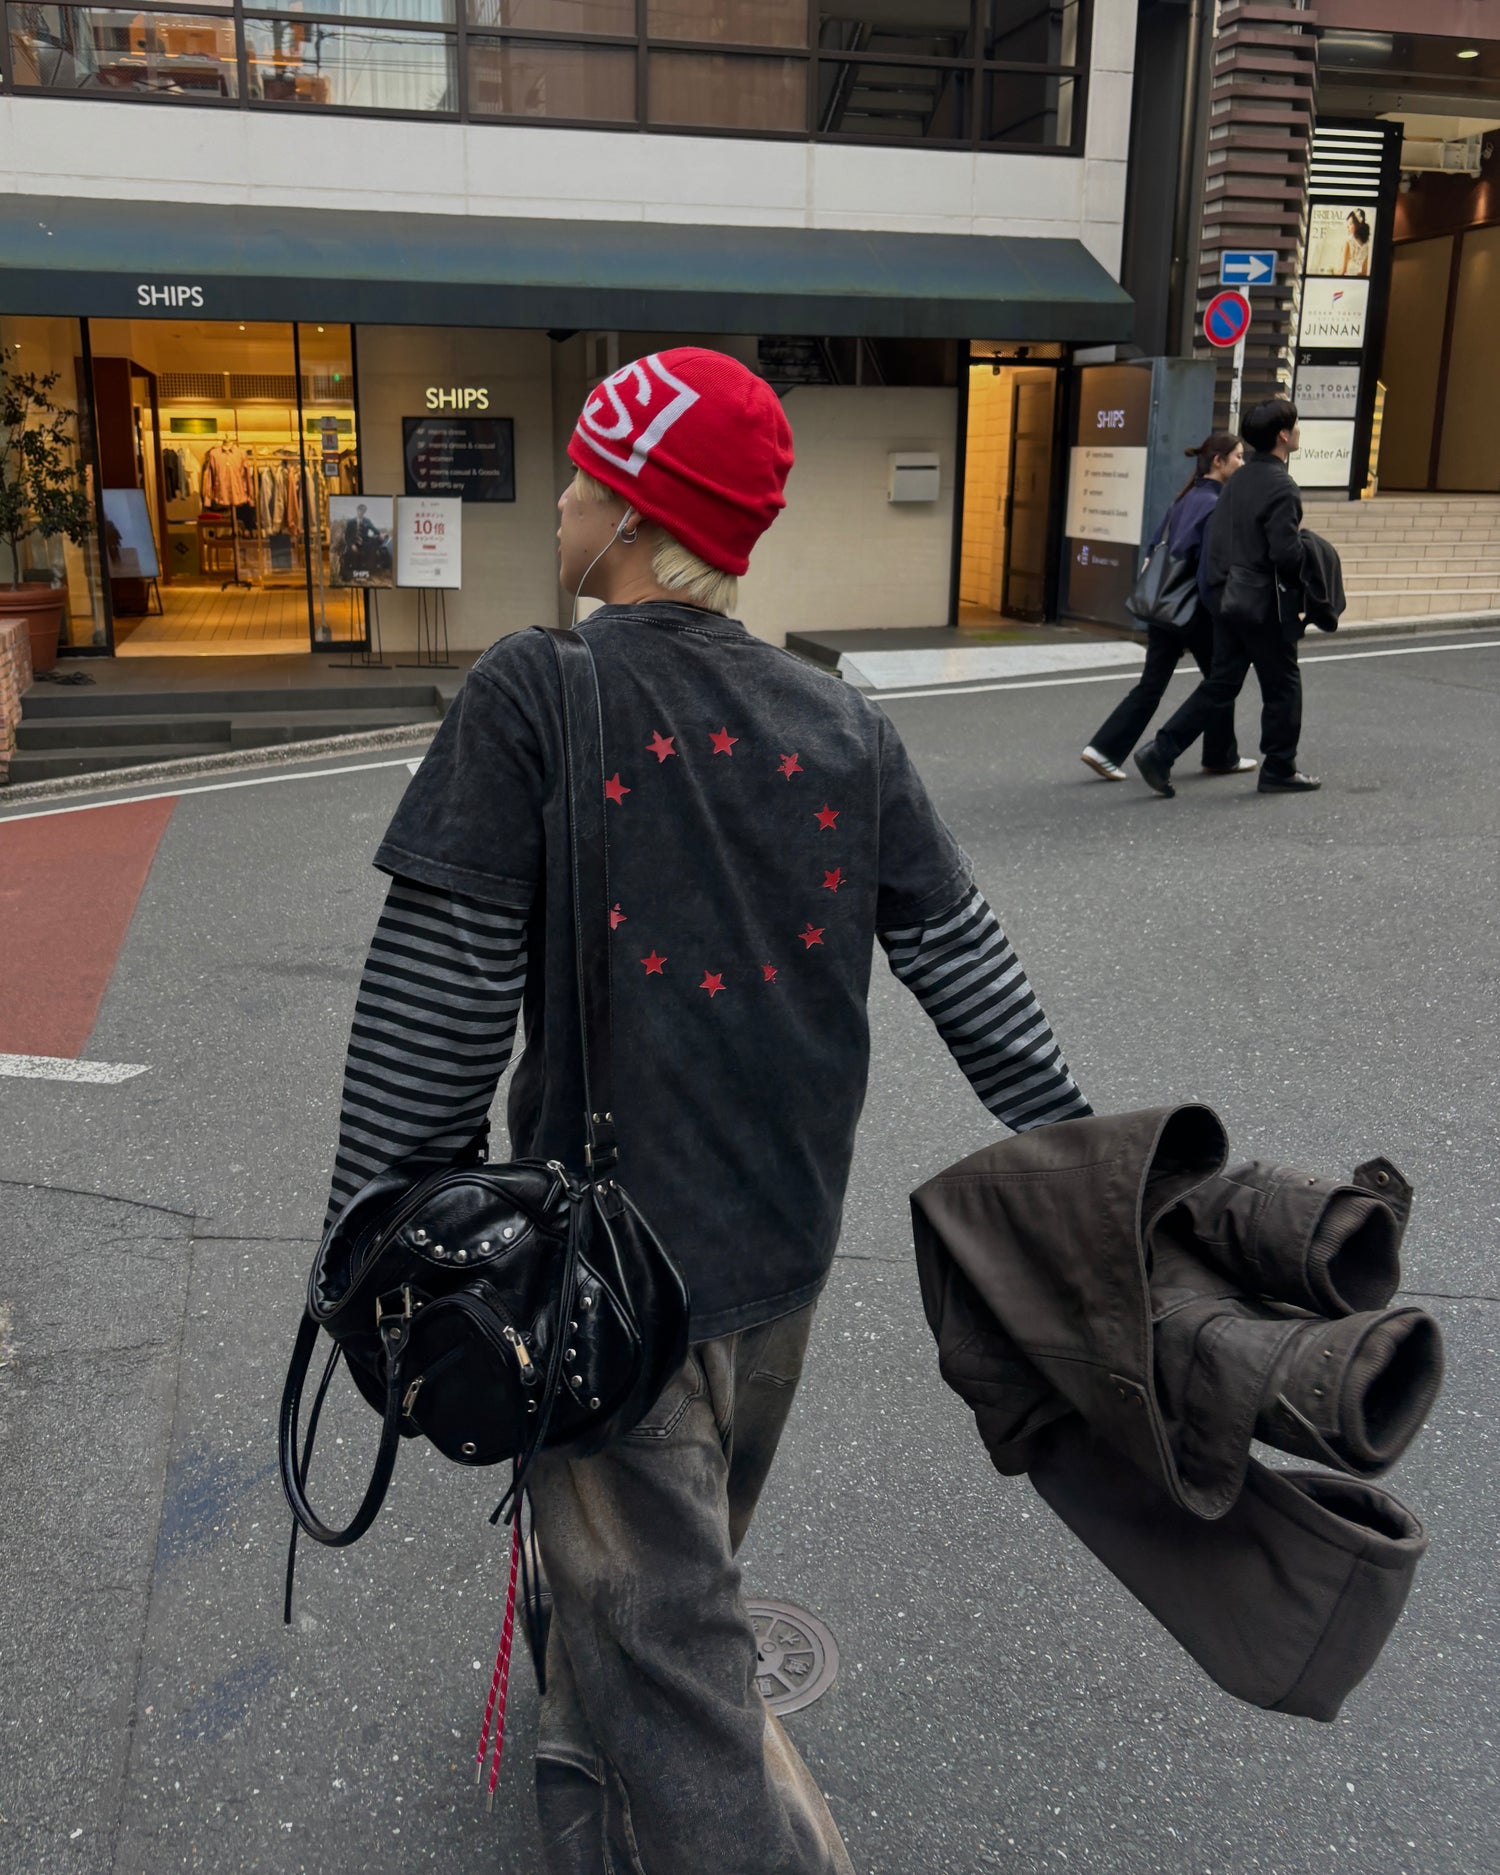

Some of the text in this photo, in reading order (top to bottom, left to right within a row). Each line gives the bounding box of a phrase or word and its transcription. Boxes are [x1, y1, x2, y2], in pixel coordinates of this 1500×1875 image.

[1312, 227, 1327, 238] 2F
[137, 284, 204, 307] SHIPS
[1305, 324, 1361, 336] JINNAN
[1301, 354, 1312, 364] 2F
[1297, 384, 1357, 392] GO TODAY
[425, 387, 489, 410] SHIPS
[1096, 410, 1125, 428] SHIPS
[1304, 449, 1350, 459] Water Air
